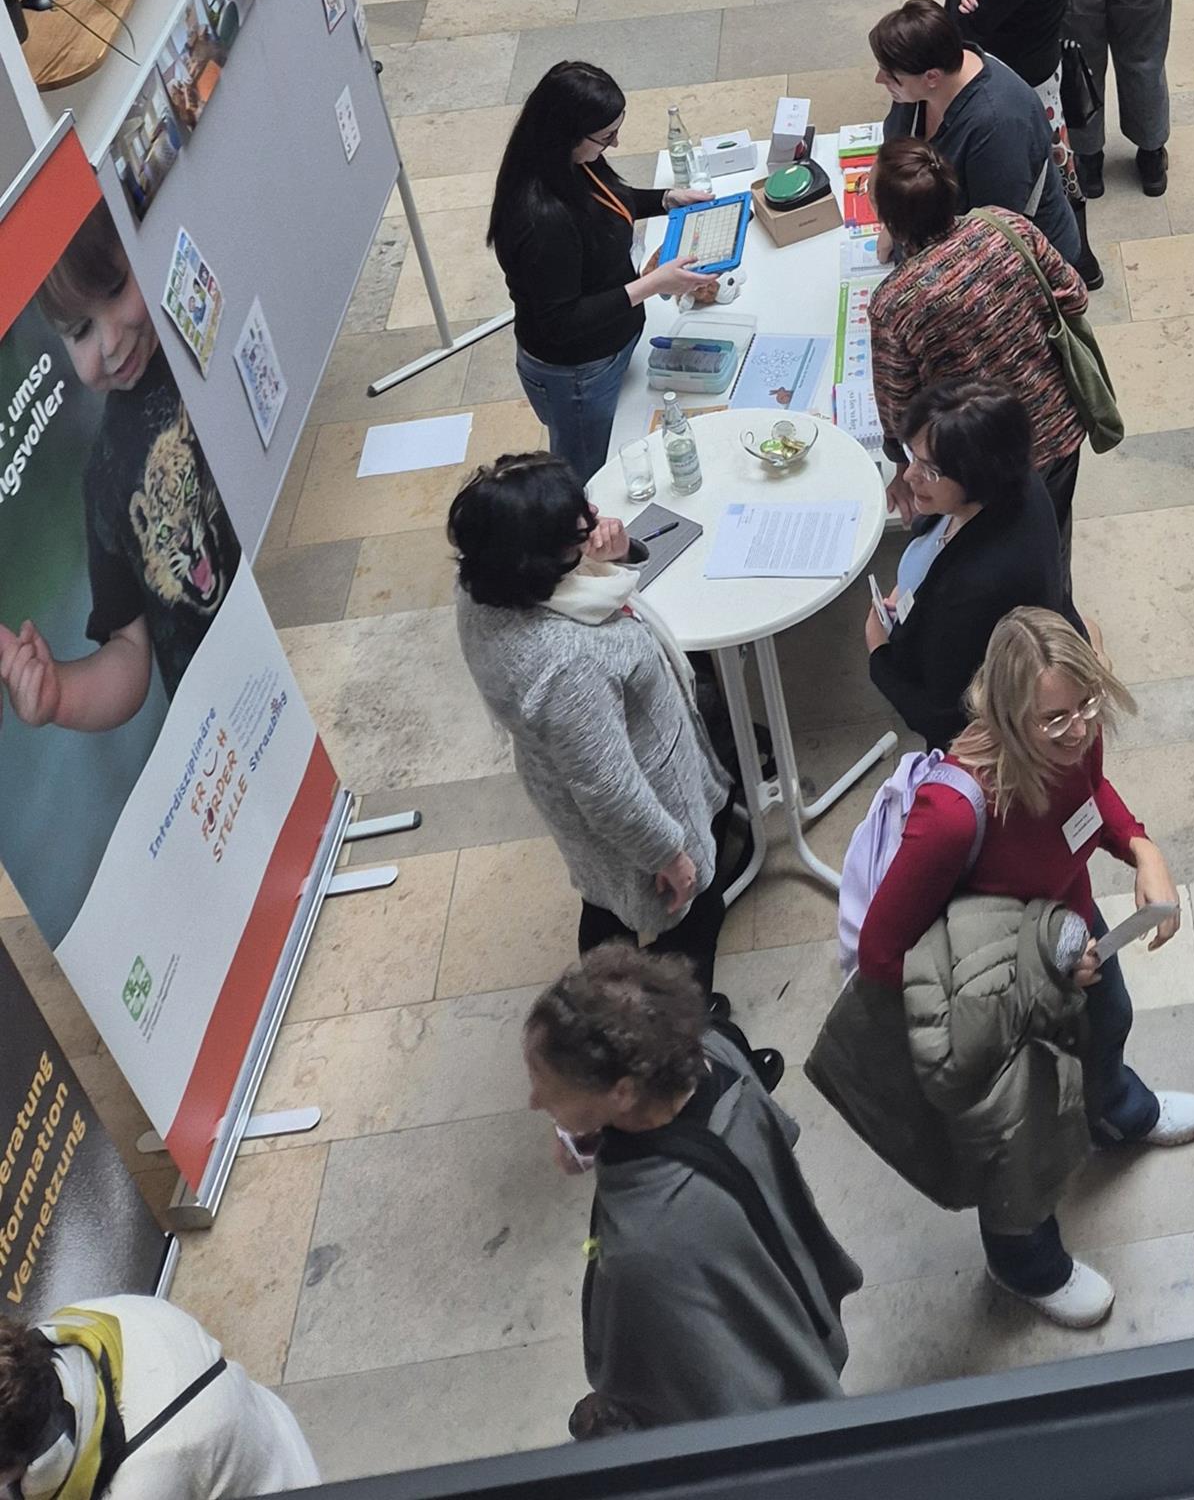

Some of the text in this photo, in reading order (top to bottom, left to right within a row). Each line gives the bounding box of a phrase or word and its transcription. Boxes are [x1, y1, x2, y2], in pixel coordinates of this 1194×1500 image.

[0, 380, 65, 503] ngsvoller
[8, 353, 51, 422] umso
[148, 706, 217, 860] Interdisziplinäre
[249, 690, 288, 773] Straubing
[213, 773, 248, 863] STELLE
[0, 1050, 54, 1198] eratung
[7, 1109, 87, 1304] Vernetzung
